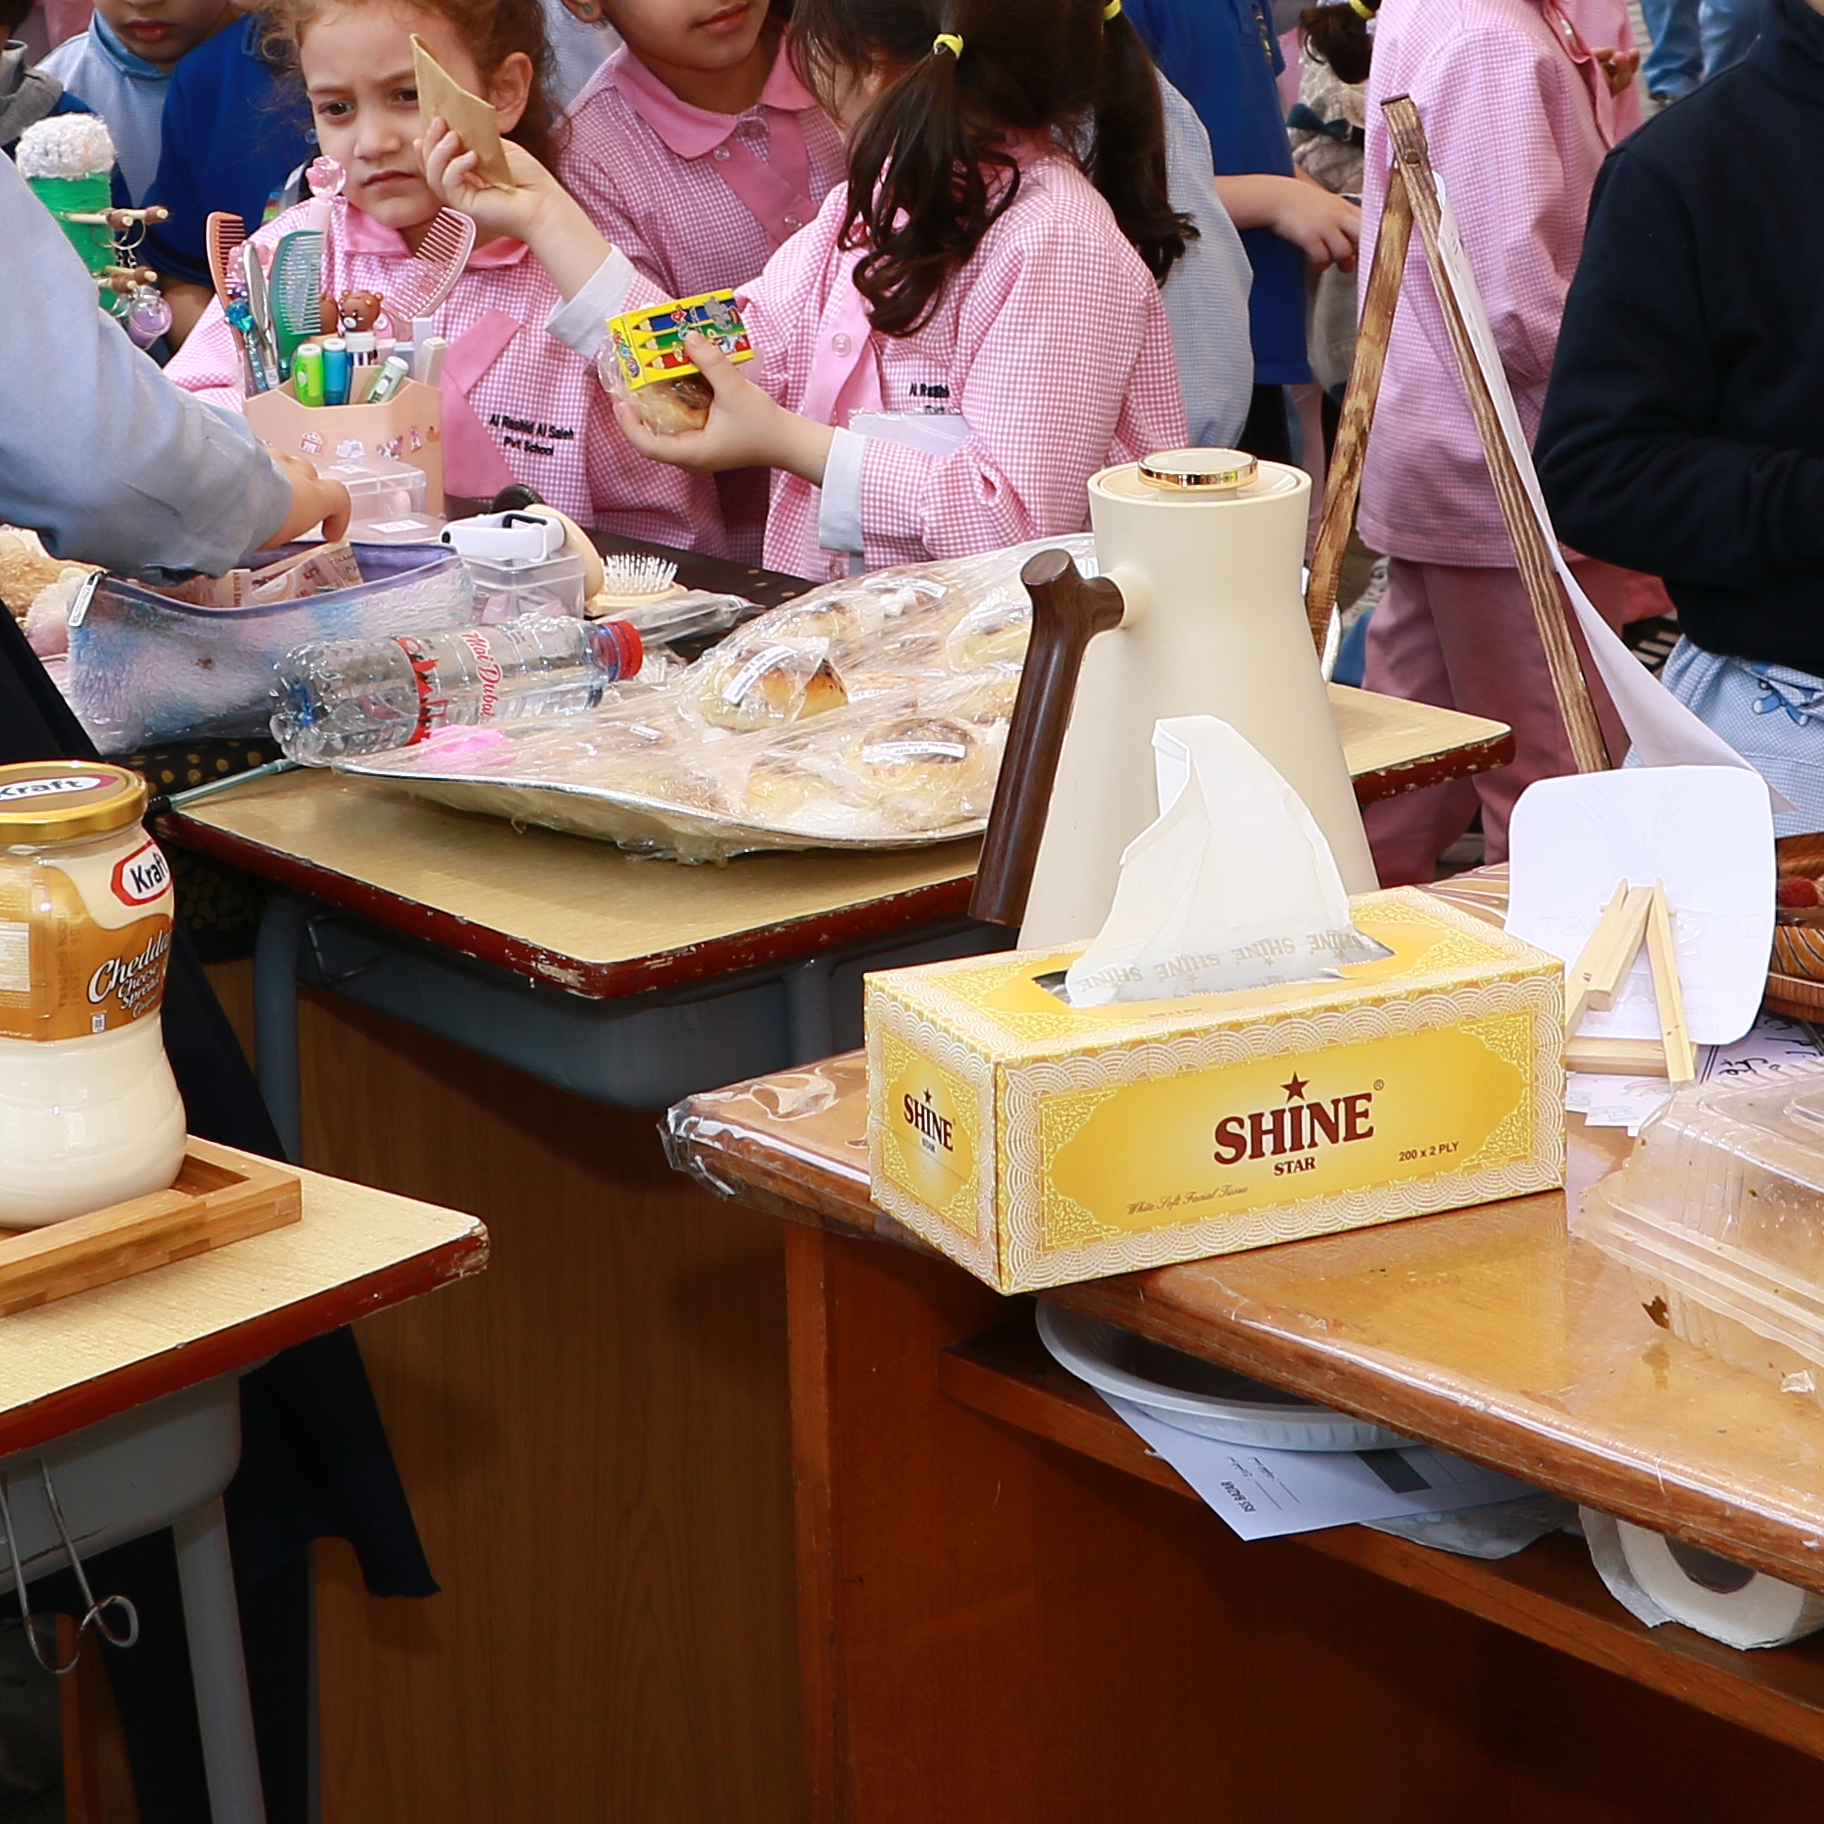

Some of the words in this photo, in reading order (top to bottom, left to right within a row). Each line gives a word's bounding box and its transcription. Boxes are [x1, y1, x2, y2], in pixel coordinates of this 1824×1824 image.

[503, 435, 522, 451] Pvt
[523, 440, 555, 457] School
[459, 630, 495, 664] Mai
[476, 663, 503, 718] Dubai
[129, 851, 169, 894] Kraft
[903, 1092, 954, 1153] SHINE
[1213, 1092, 1375, 1165] SHINE
[1272, 1155, 1317, 1177] STAR
[1398, 1149, 1419, 1162] 200
[1420, 1149, 1428, 1159] x
[1429, 1145, 1437, 1156] 2
[1438, 1141, 1461, 1155] PLY
[1126, 1200, 1155, 1216] White
[1156, 1194, 1182, 1212] Soft
[1181, 1189, 1219, 1206] Facial
[1219, 1183, 1249, 1199] Tissue
